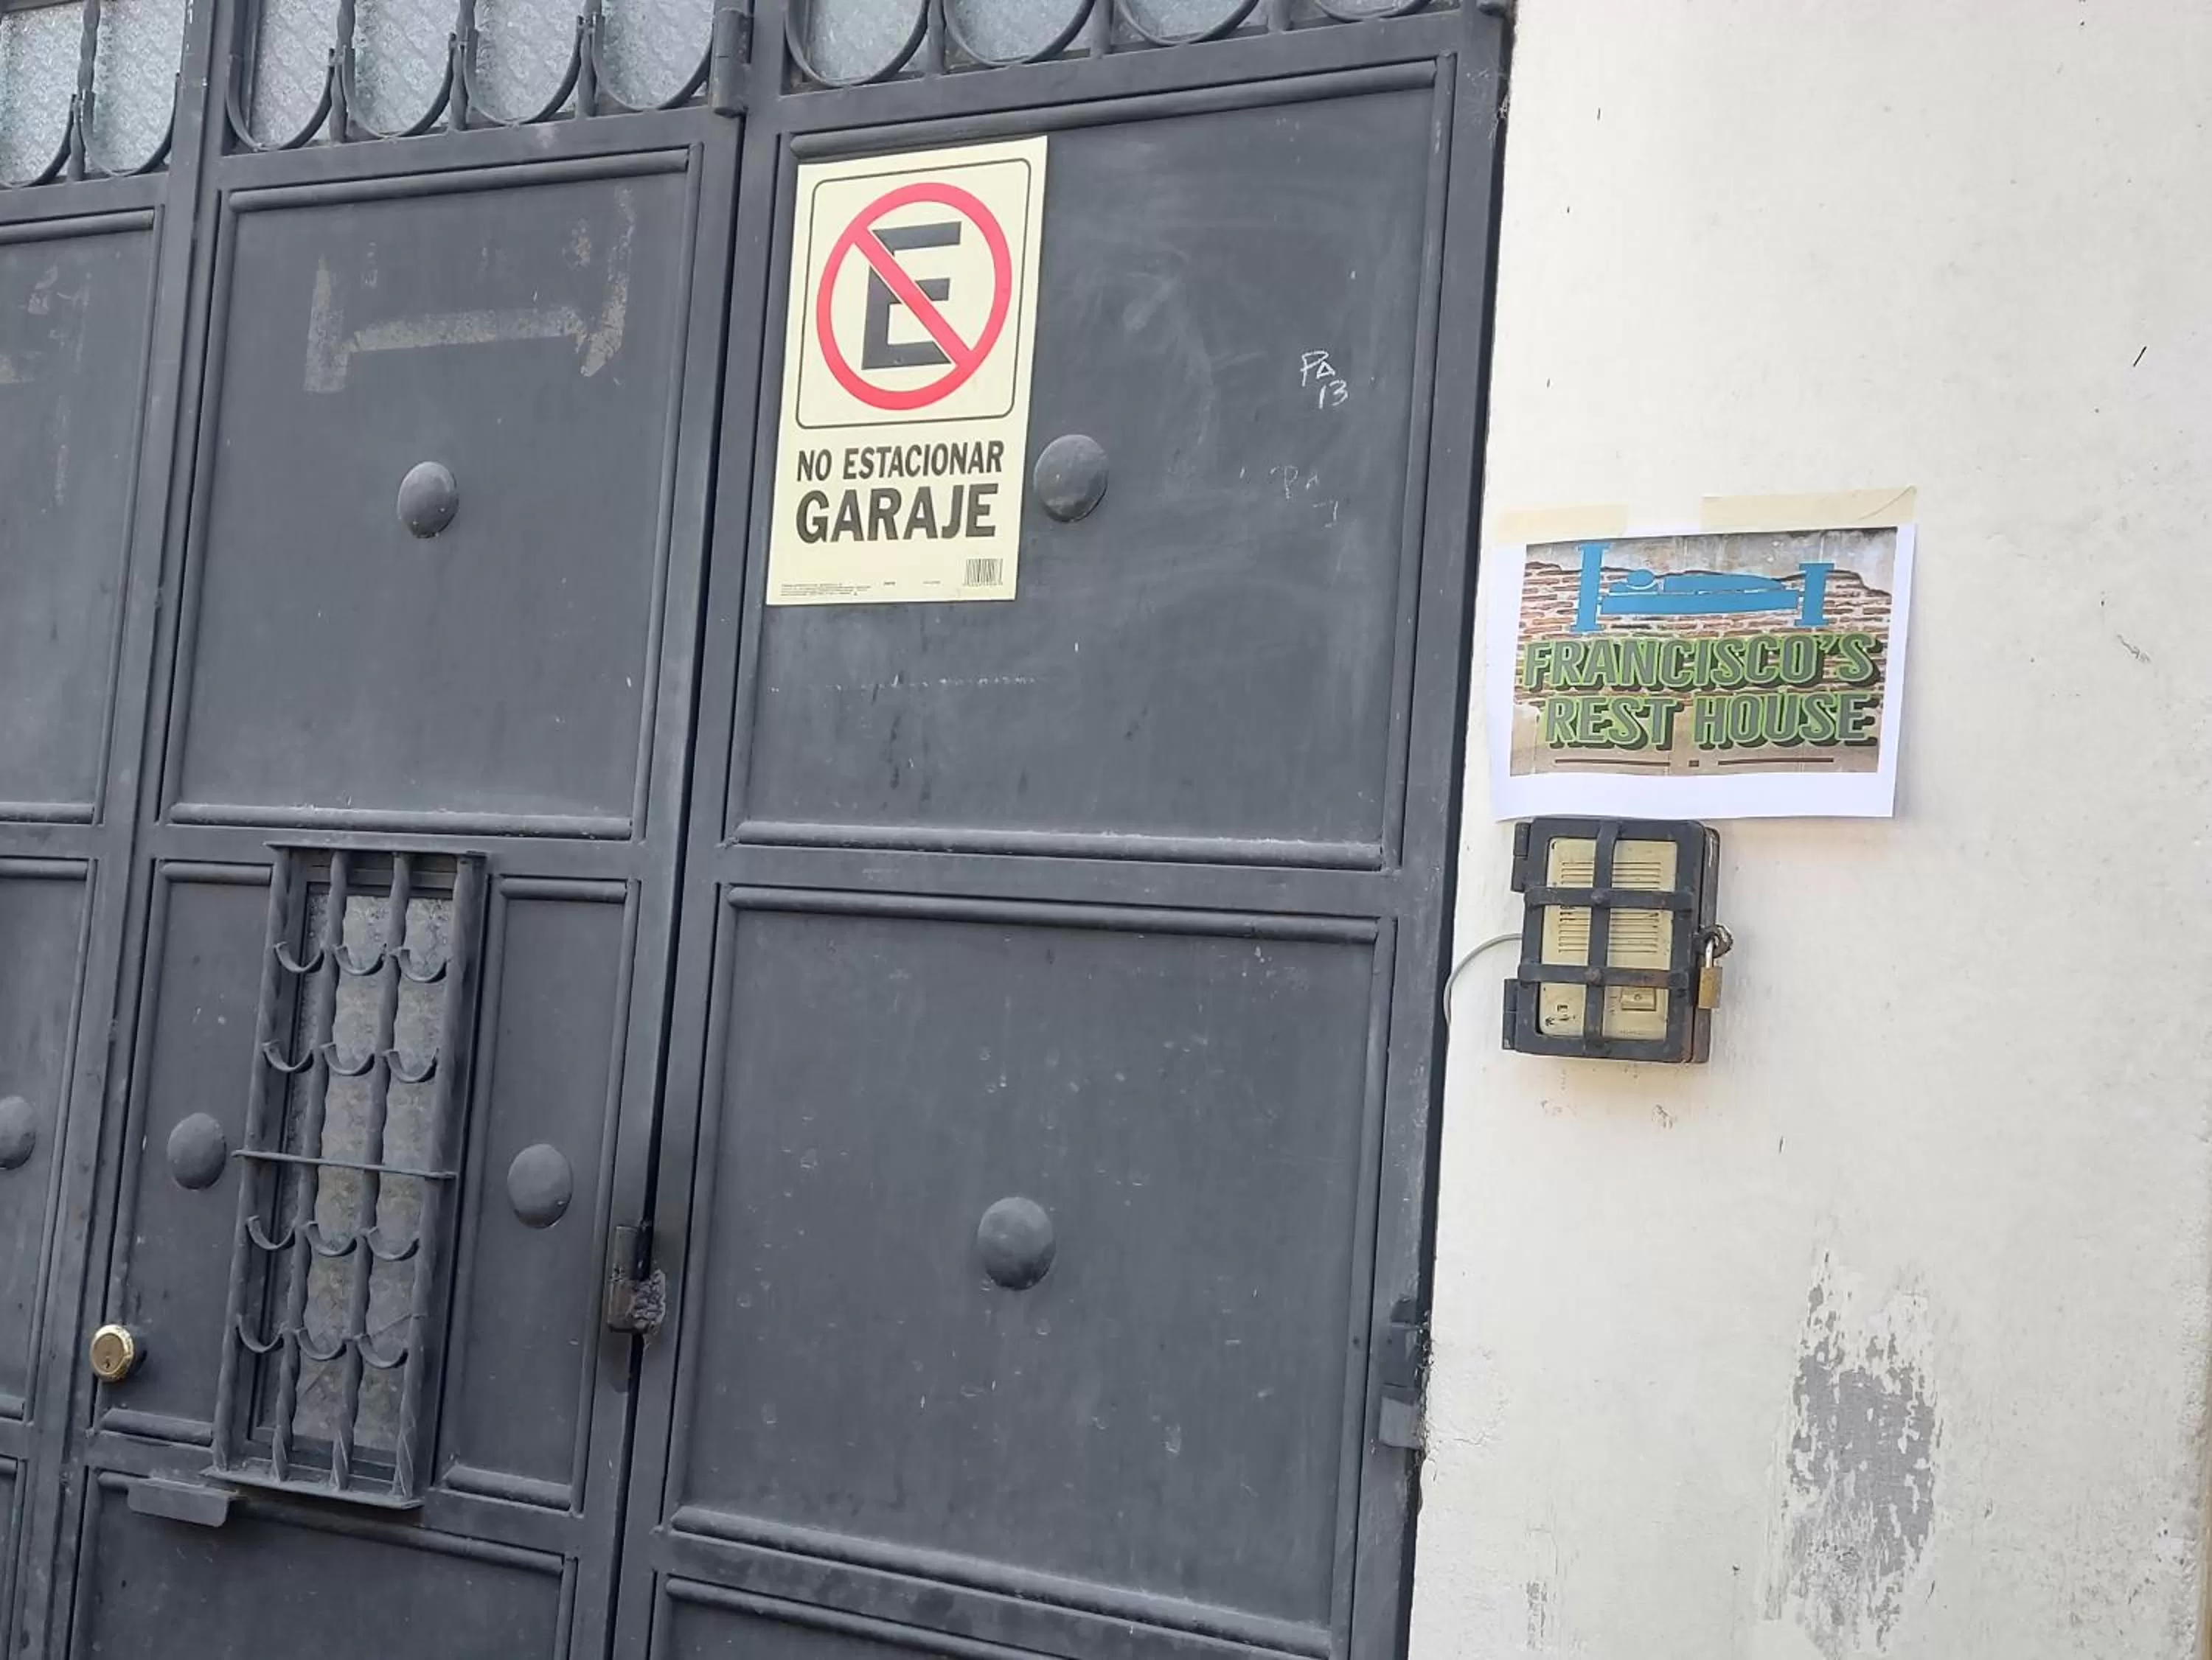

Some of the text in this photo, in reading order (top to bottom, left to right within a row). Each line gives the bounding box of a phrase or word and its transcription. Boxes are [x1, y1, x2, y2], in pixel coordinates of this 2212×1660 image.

[862, 221, 961, 369] E
[796, 440, 1004, 481] NO ESTACIONAR
[796, 483, 998, 543] GARAJE
[1523, 632, 1882, 691] FRANCISCO'S
[1546, 690, 1879, 750] REST HOUSE
